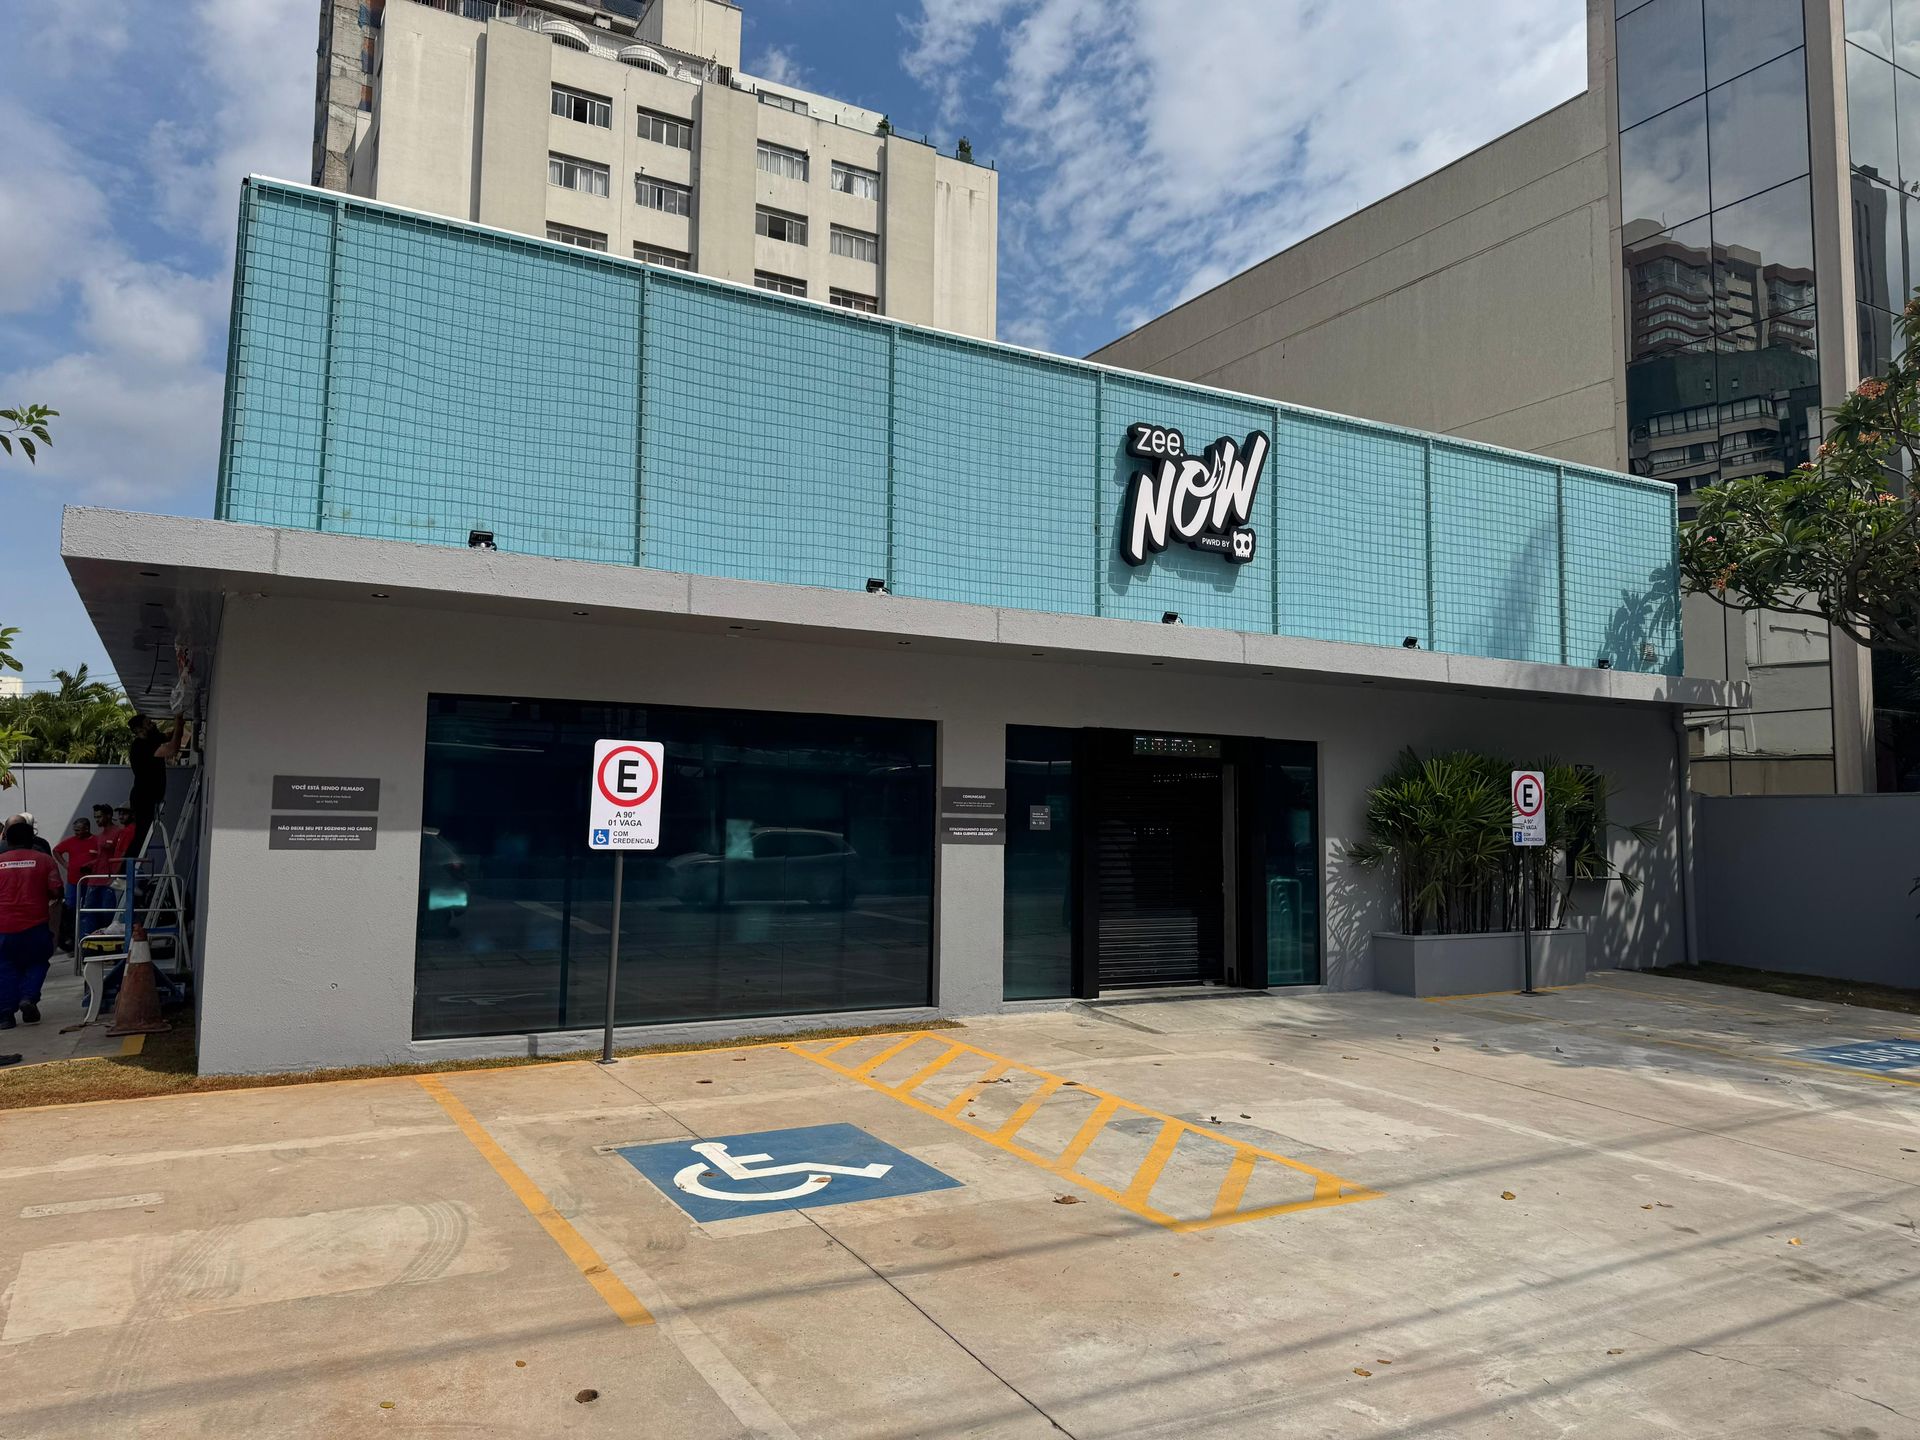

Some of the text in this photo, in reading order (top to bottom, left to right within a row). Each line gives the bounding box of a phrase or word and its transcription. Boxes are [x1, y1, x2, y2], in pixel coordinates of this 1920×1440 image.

[1136, 427, 1184, 457] zee.
[1131, 435, 1267, 560] NOW
[1202, 537, 1230, 548] PWRD BY
[617, 759, 639, 793] E
[1523, 784, 1533, 807] E
[608, 819, 642, 827] 01 VAGA
